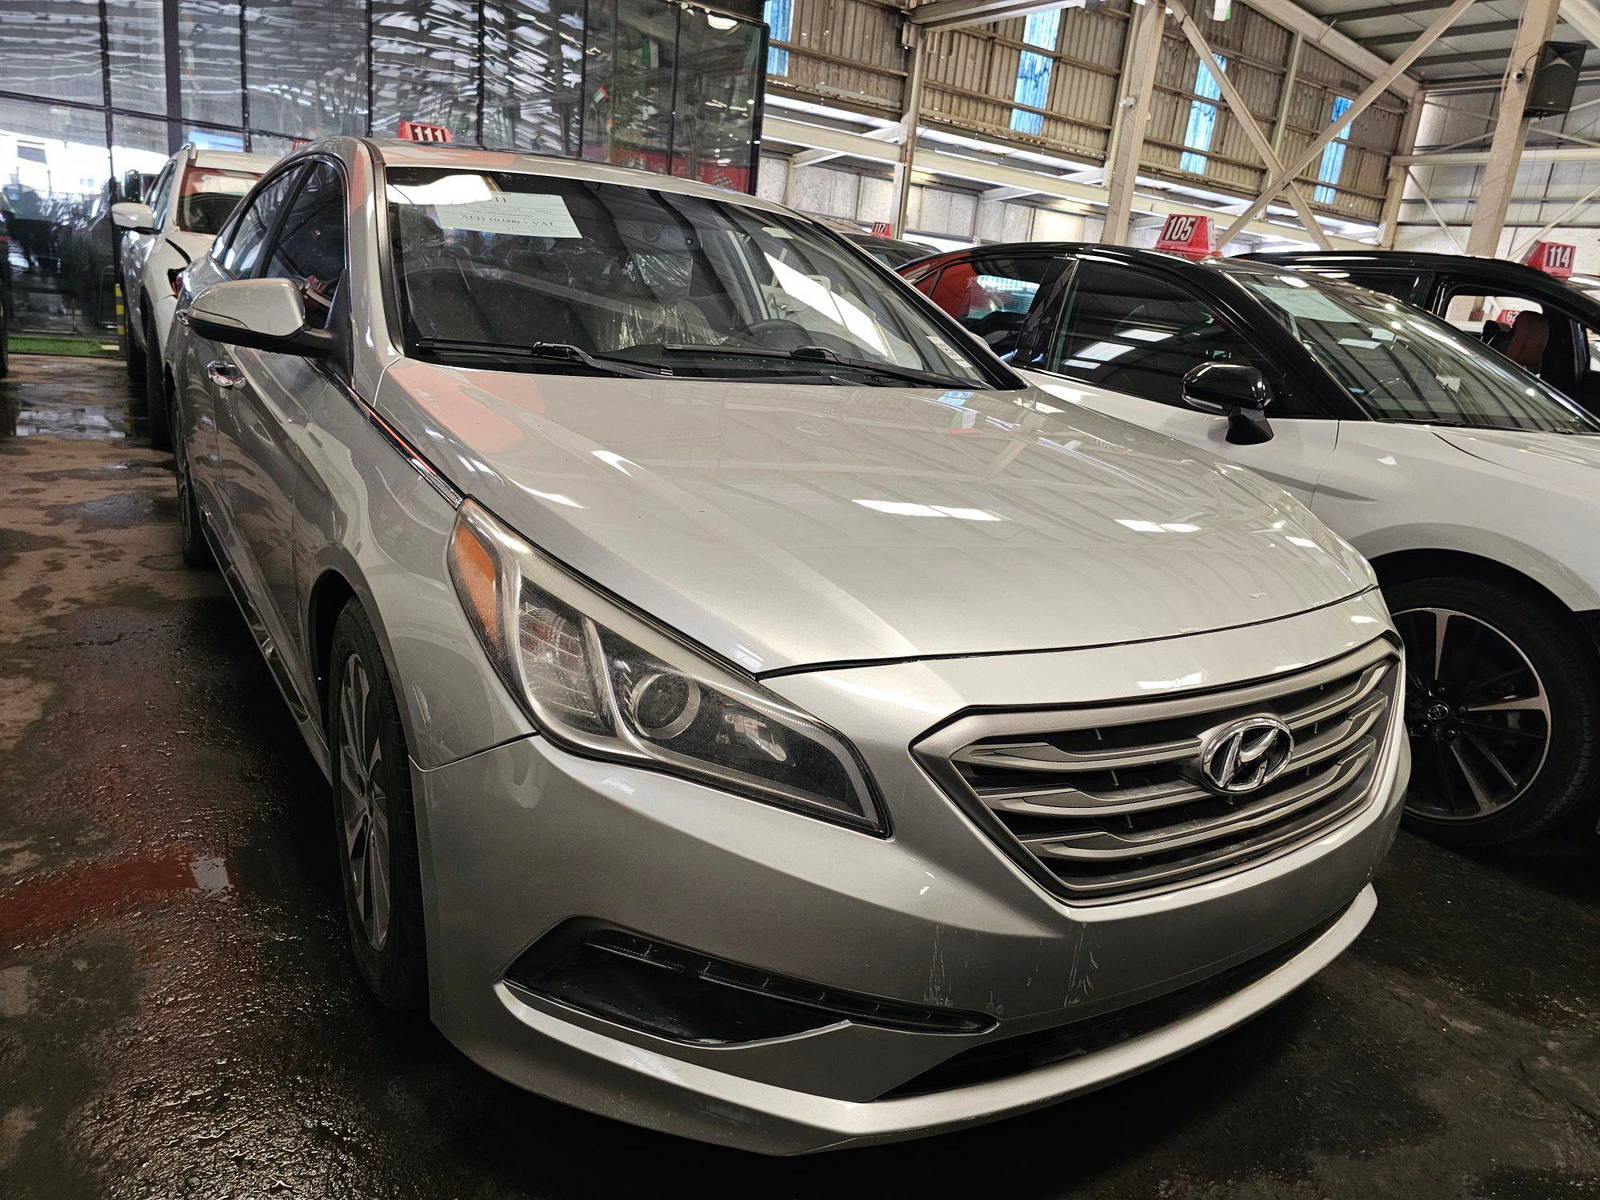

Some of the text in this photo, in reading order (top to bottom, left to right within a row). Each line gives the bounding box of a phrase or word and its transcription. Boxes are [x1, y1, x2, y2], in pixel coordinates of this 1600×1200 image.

[414, 126, 444, 142] 111
[1164, 216, 1196, 241] 105
[1549, 246, 1572, 268] 114
